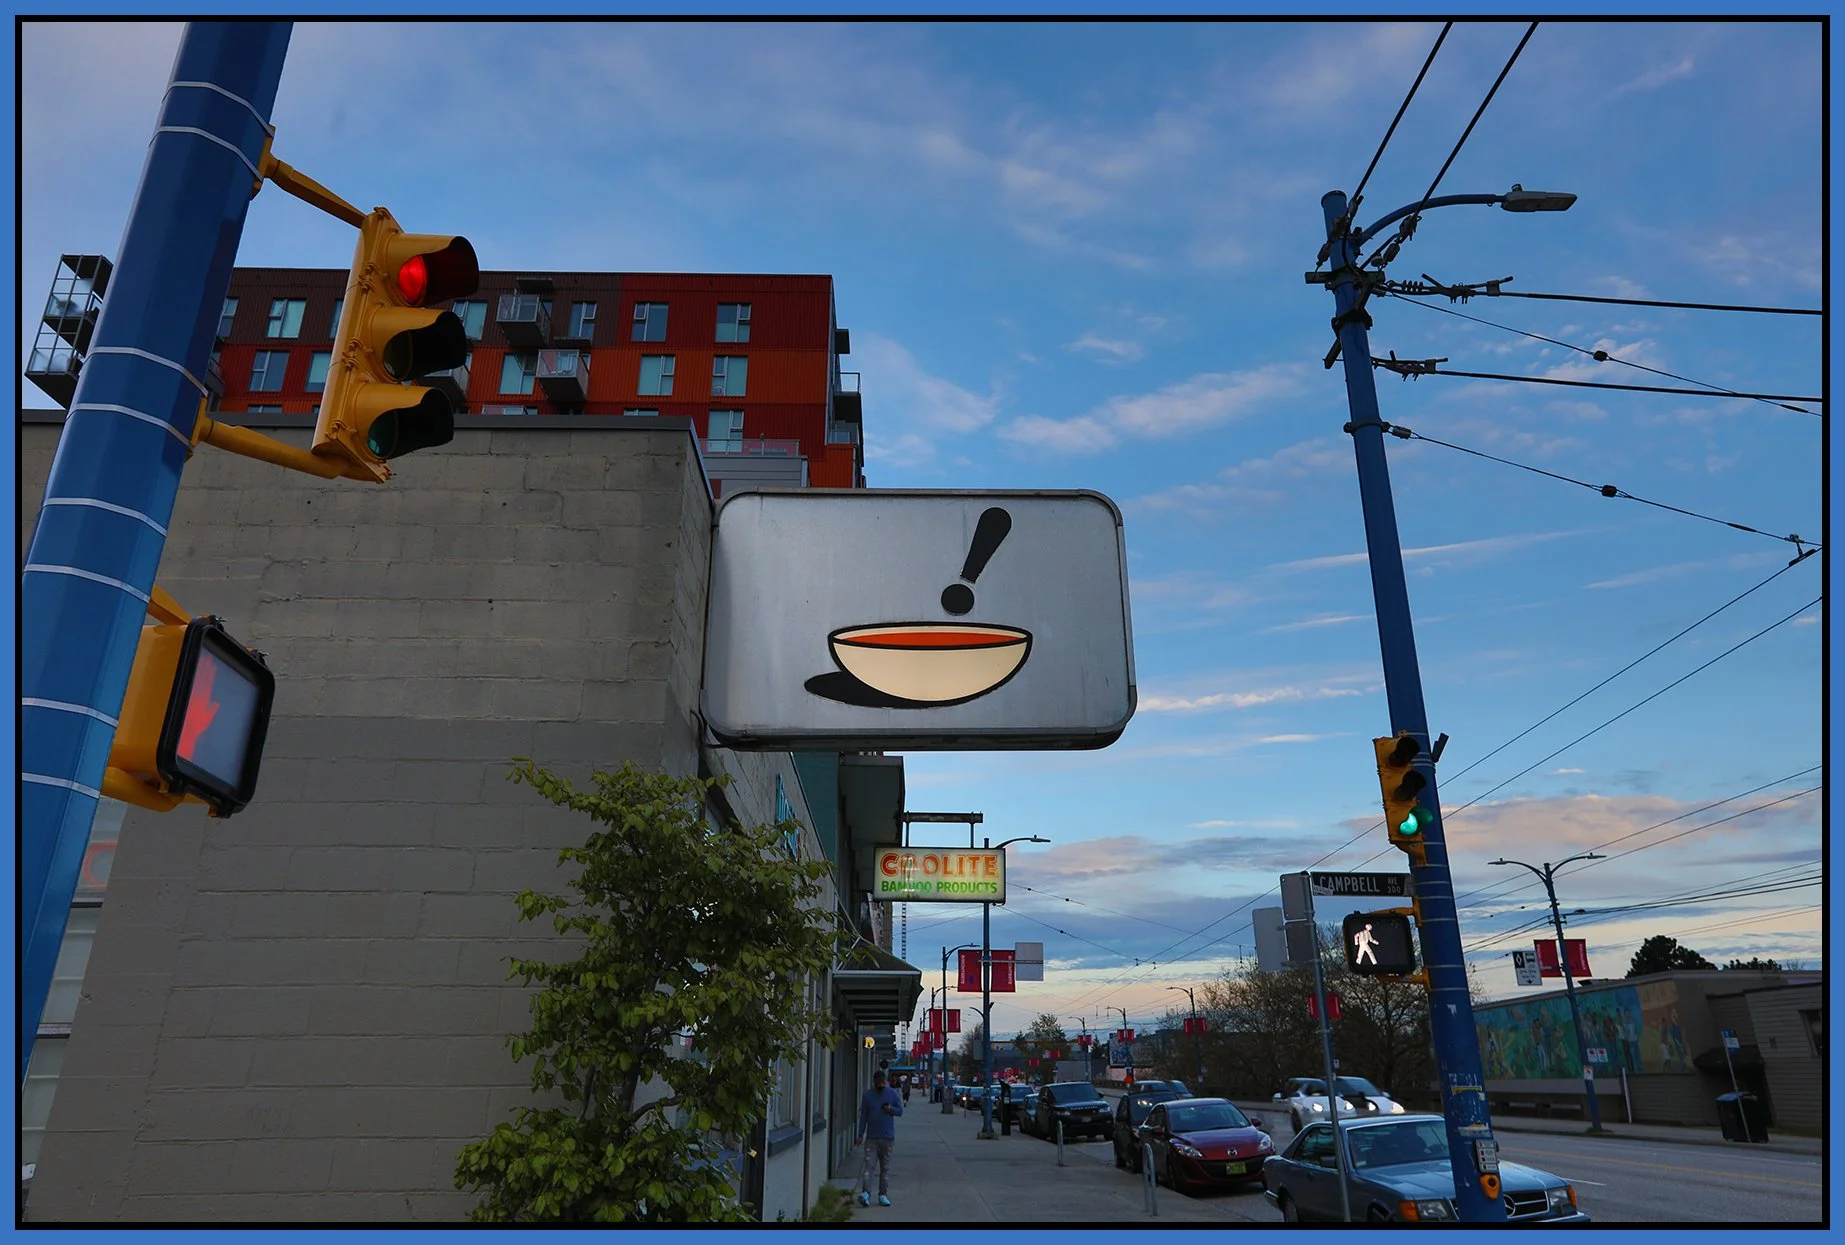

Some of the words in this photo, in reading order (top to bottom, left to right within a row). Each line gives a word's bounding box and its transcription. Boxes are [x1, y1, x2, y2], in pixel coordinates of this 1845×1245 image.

[880, 852, 999, 877] COOLITE
[936, 881, 998, 894] PRODUCTS
[1320, 876, 1381, 893] CAMPBELL
